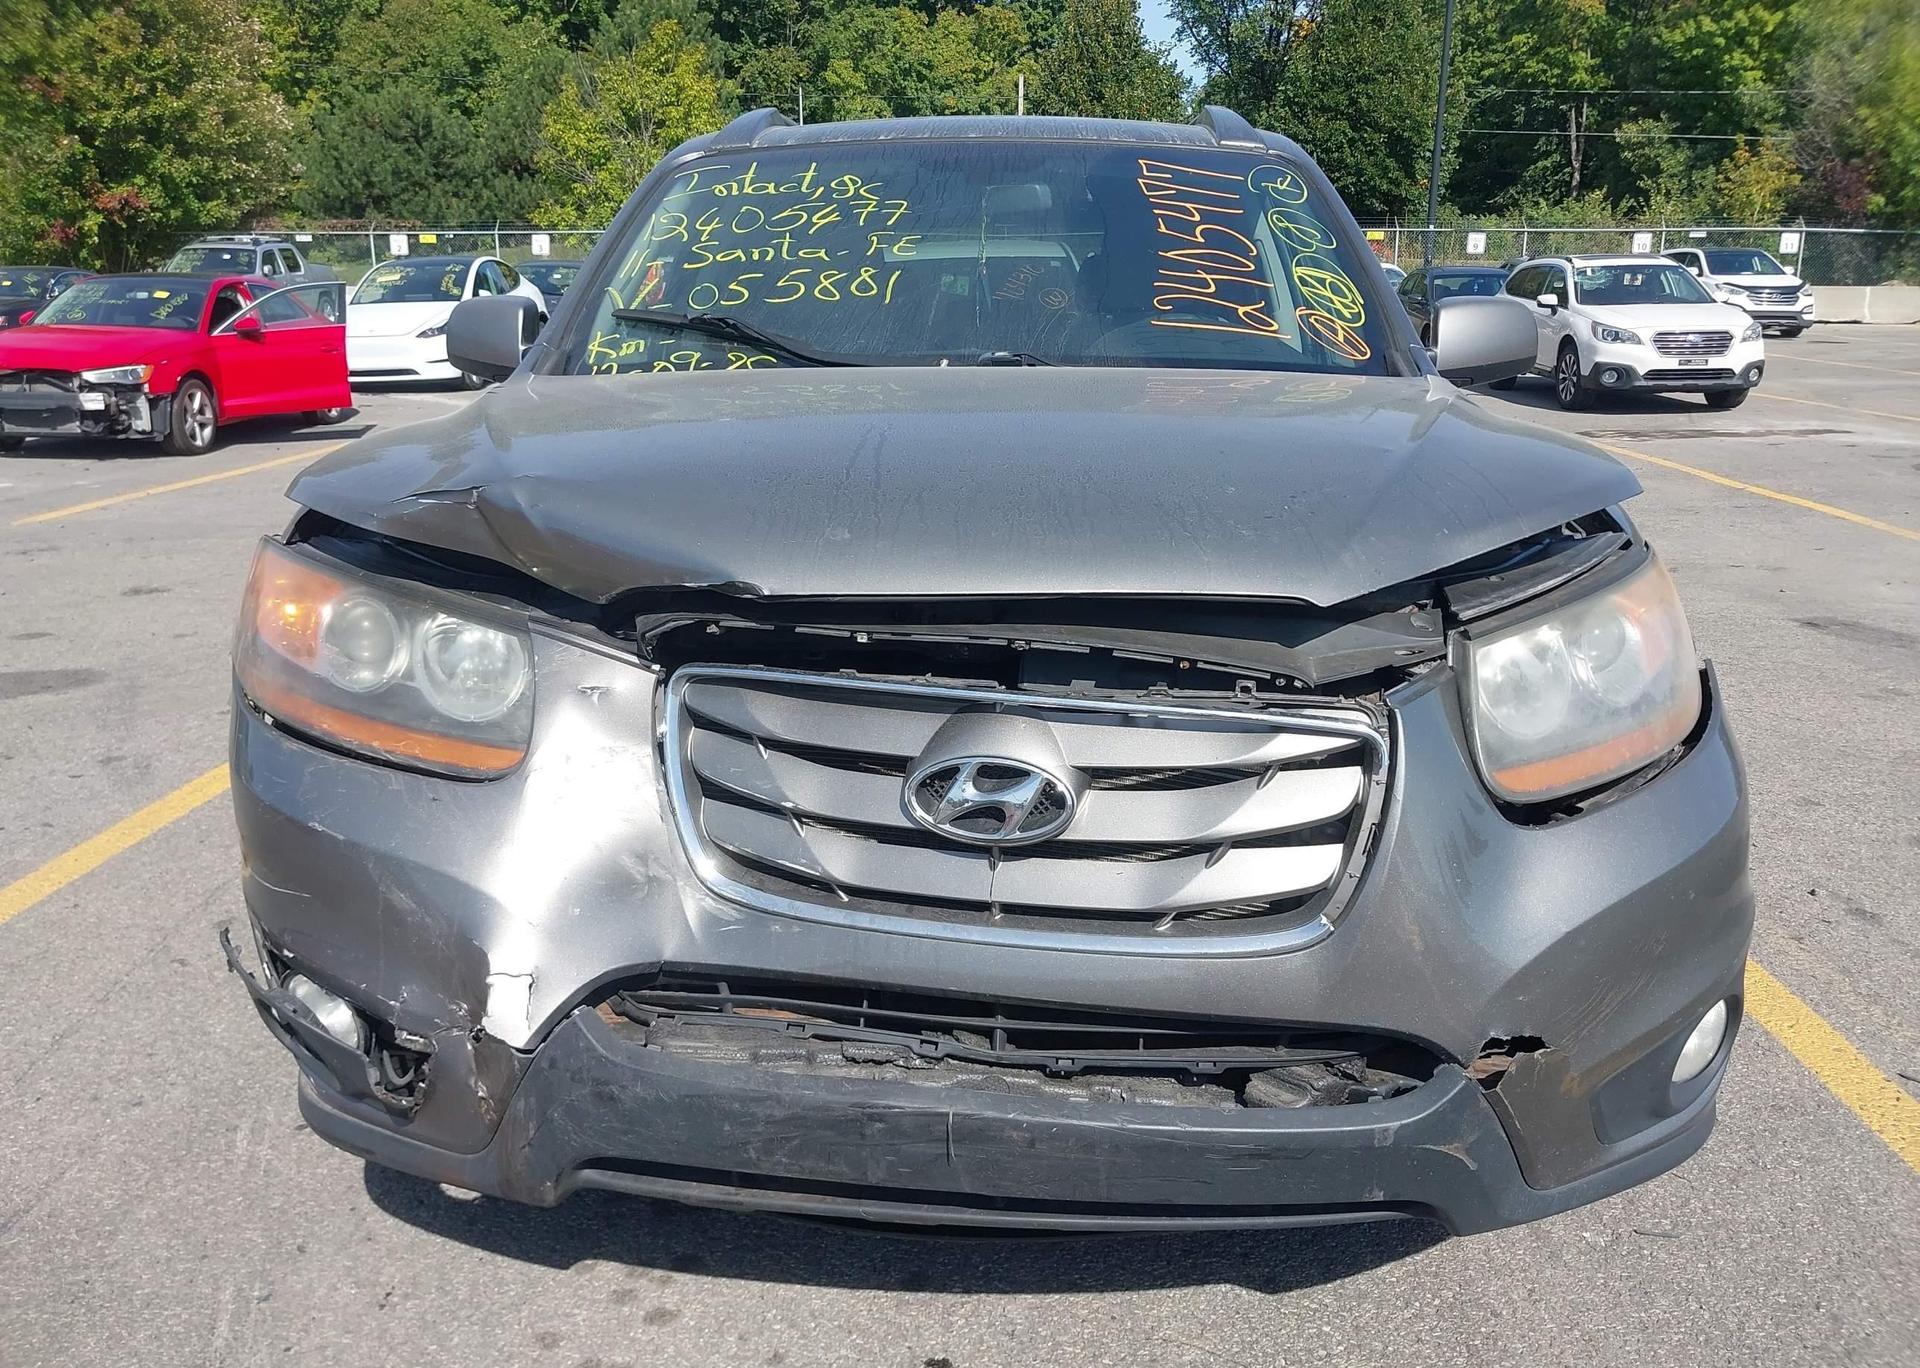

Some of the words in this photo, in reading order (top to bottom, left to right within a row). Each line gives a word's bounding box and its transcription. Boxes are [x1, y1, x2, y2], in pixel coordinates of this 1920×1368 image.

[644, 200, 912, 241] 12405477
[1138, 158, 1291, 339] 12405477
[1636, 242, 1648, 251] 10
[688, 267, 901, 310] 055881
